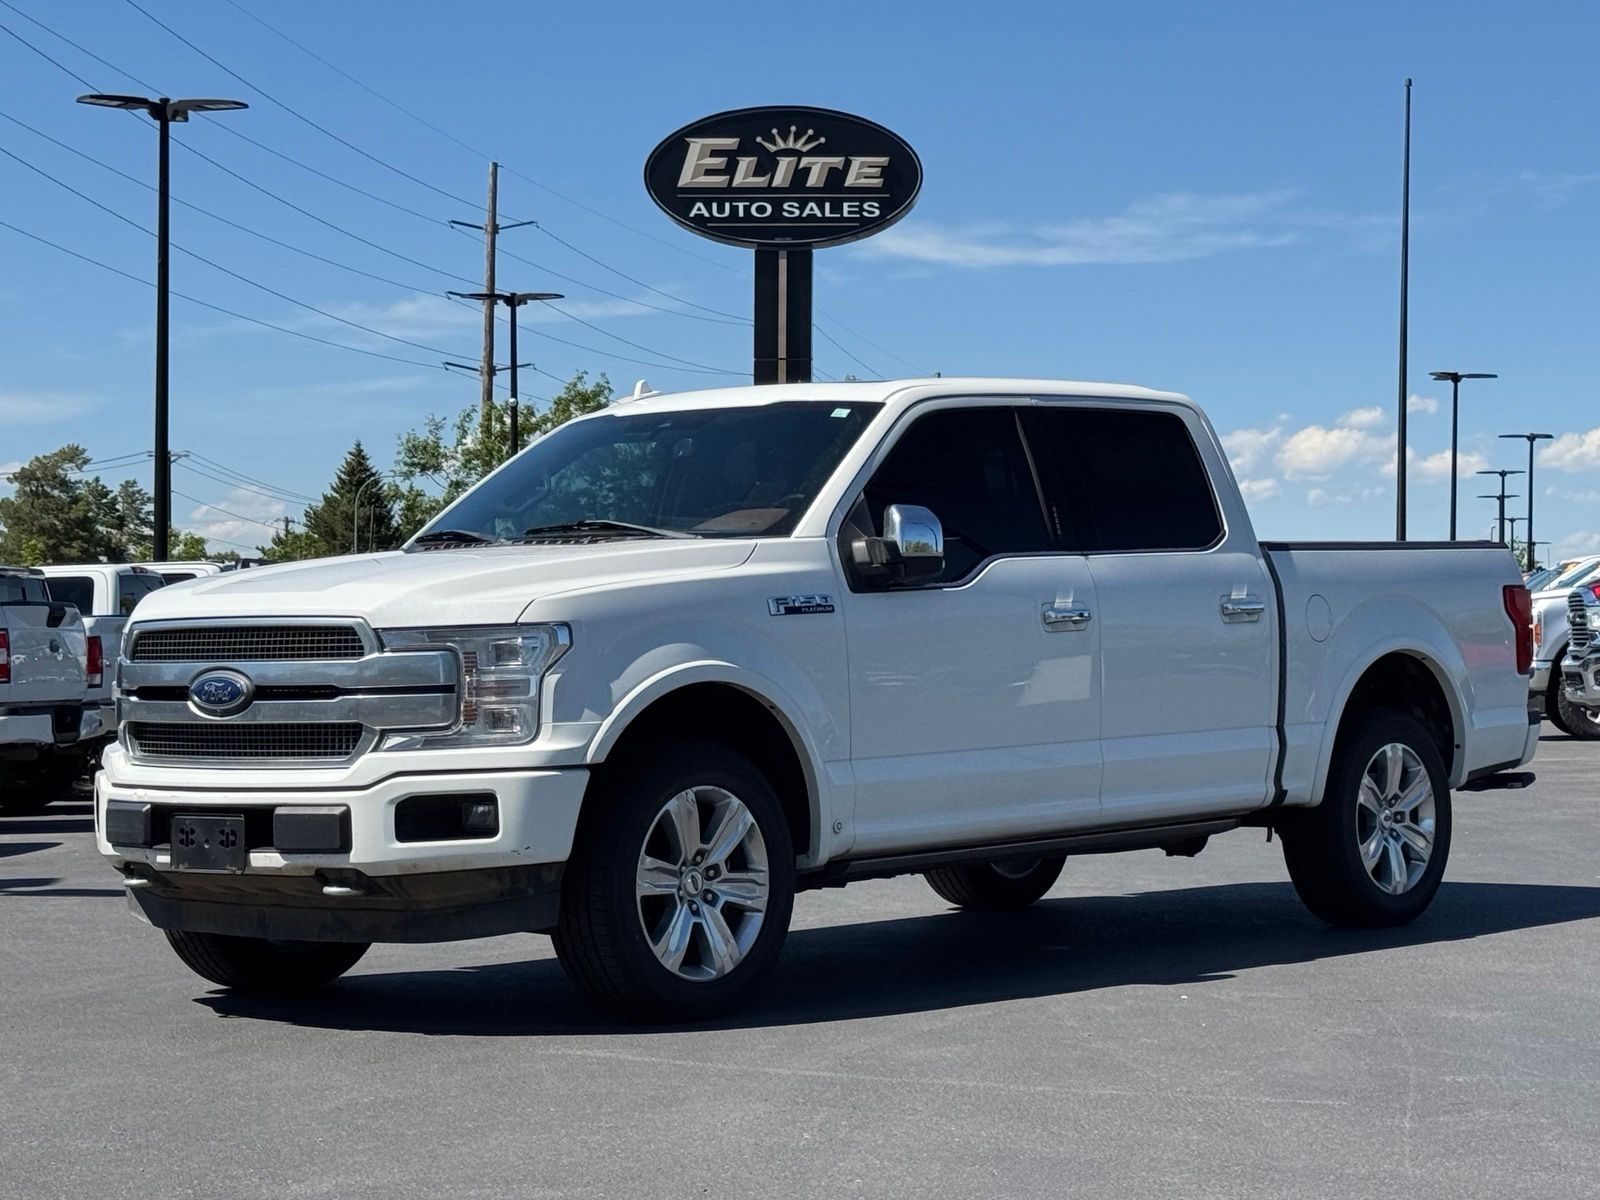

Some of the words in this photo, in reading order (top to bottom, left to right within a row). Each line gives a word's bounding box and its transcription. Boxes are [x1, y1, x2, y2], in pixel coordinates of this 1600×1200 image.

[676, 137, 891, 188] ELITE
[689, 201, 773, 218] AUTO
[782, 201, 881, 218] SALES
[201, 681, 232, 702] Ford
